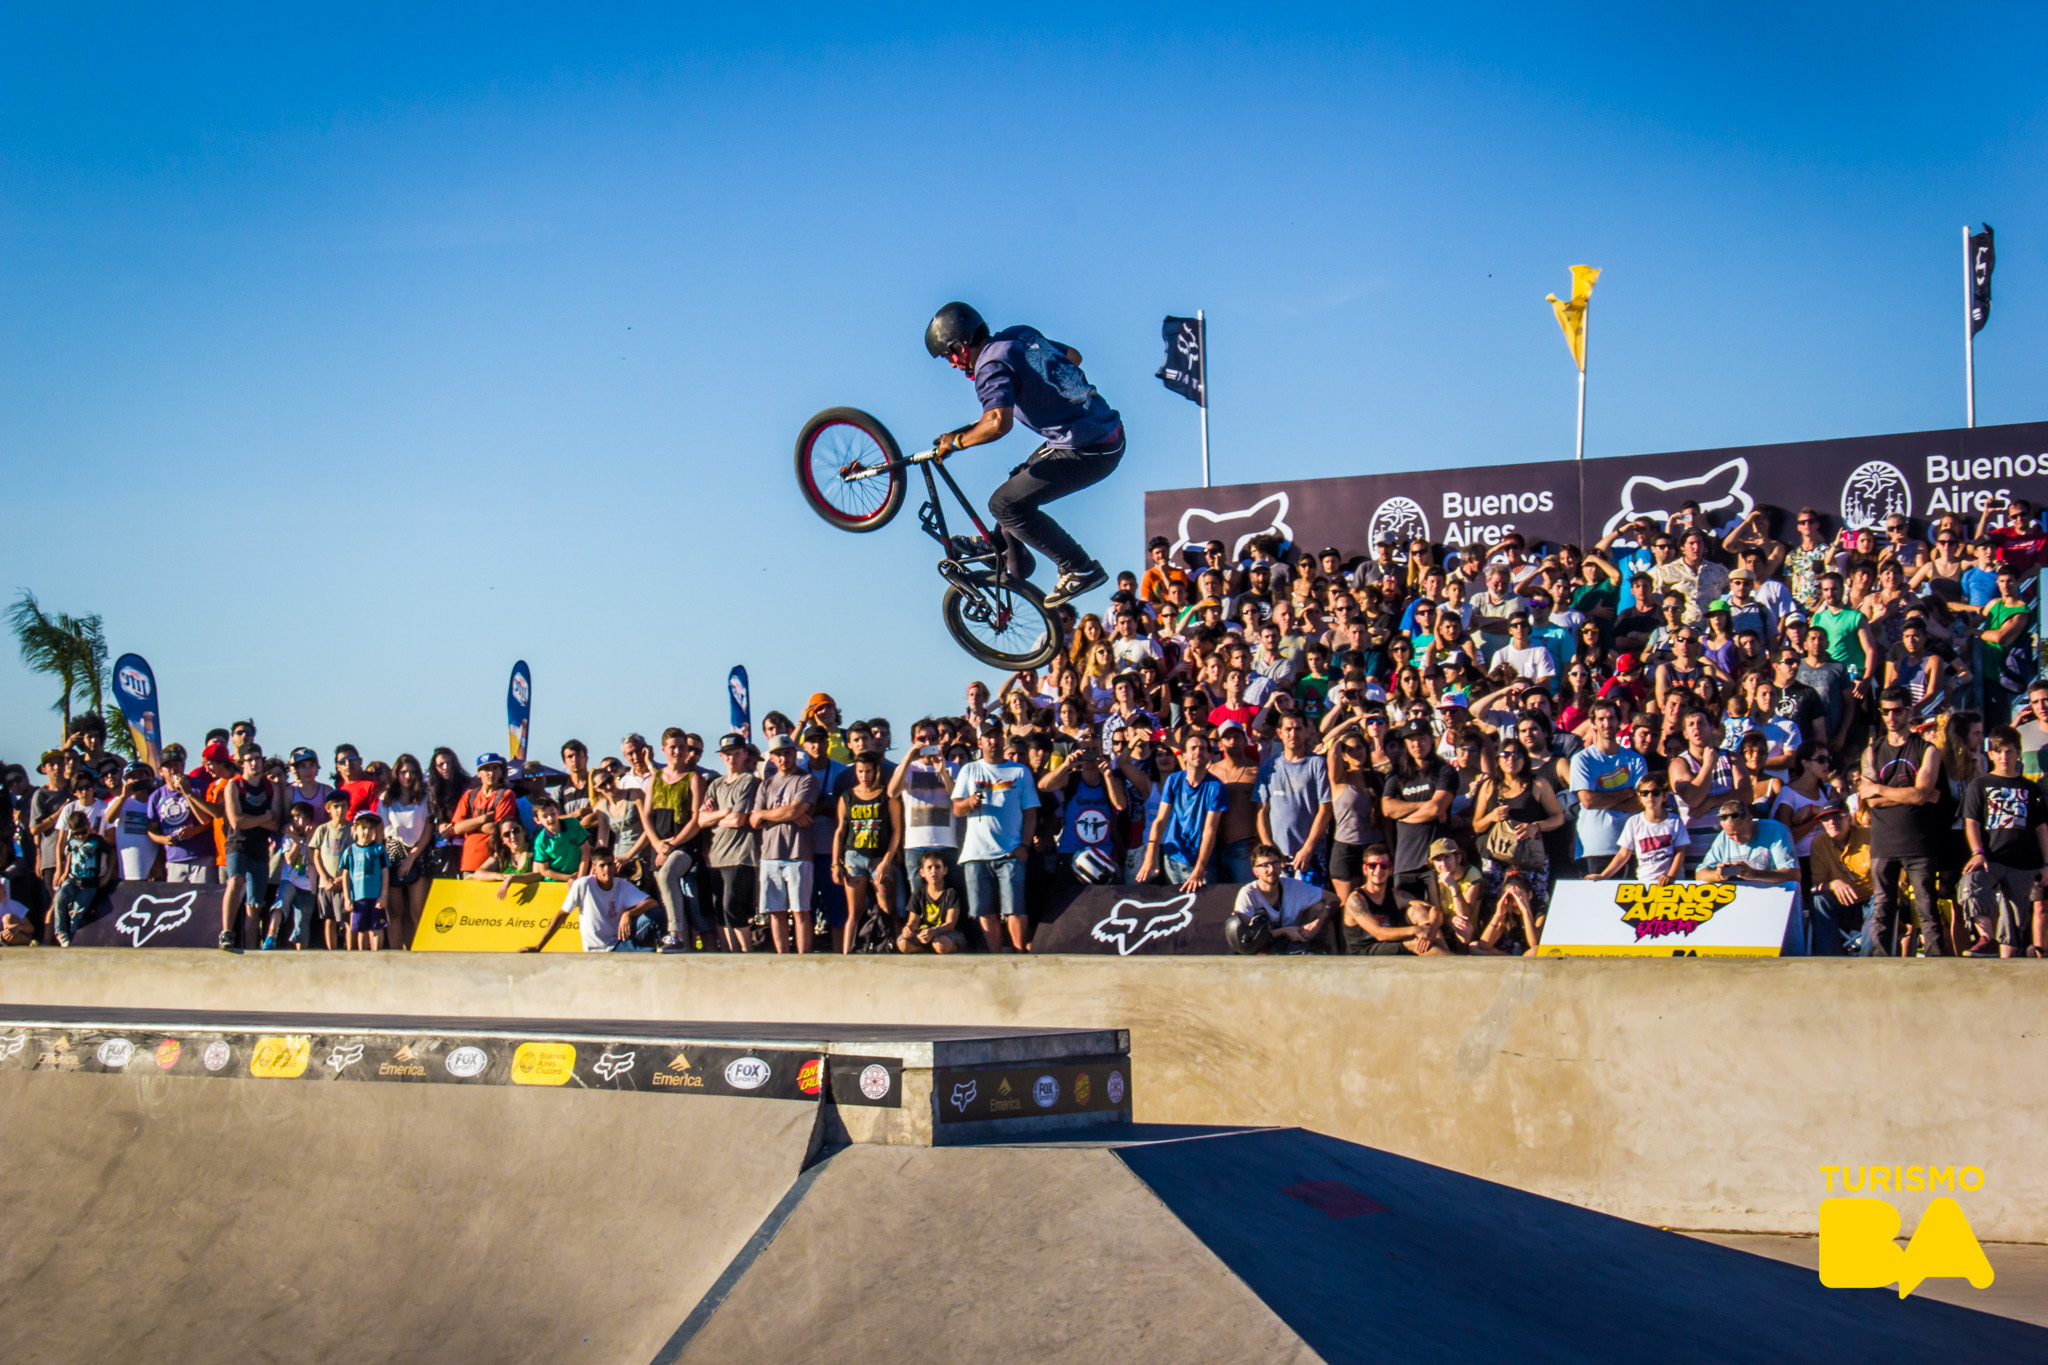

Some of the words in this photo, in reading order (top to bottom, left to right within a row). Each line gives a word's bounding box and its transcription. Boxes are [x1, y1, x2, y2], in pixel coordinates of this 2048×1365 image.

[1926, 453, 2048, 483] Buenos
[1443, 491, 1554, 518] Buenos
[1615, 884, 1737, 904] BUENOS
[1622, 902, 1714, 921] AIRES
[459, 916, 502, 927] Buenos
[505, 917, 535, 928] Aires
[1635, 917, 1699, 943] EXTREMO
[107, 1044, 128, 1056] FOX
[455, 1052, 479, 1065] FOX
[379, 1063, 427, 1076] Emerica.
[735, 1064, 761, 1077] FOX
[652, 1072, 704, 1087] Emerica.
[1039, 1082, 1054, 1095] FOX
